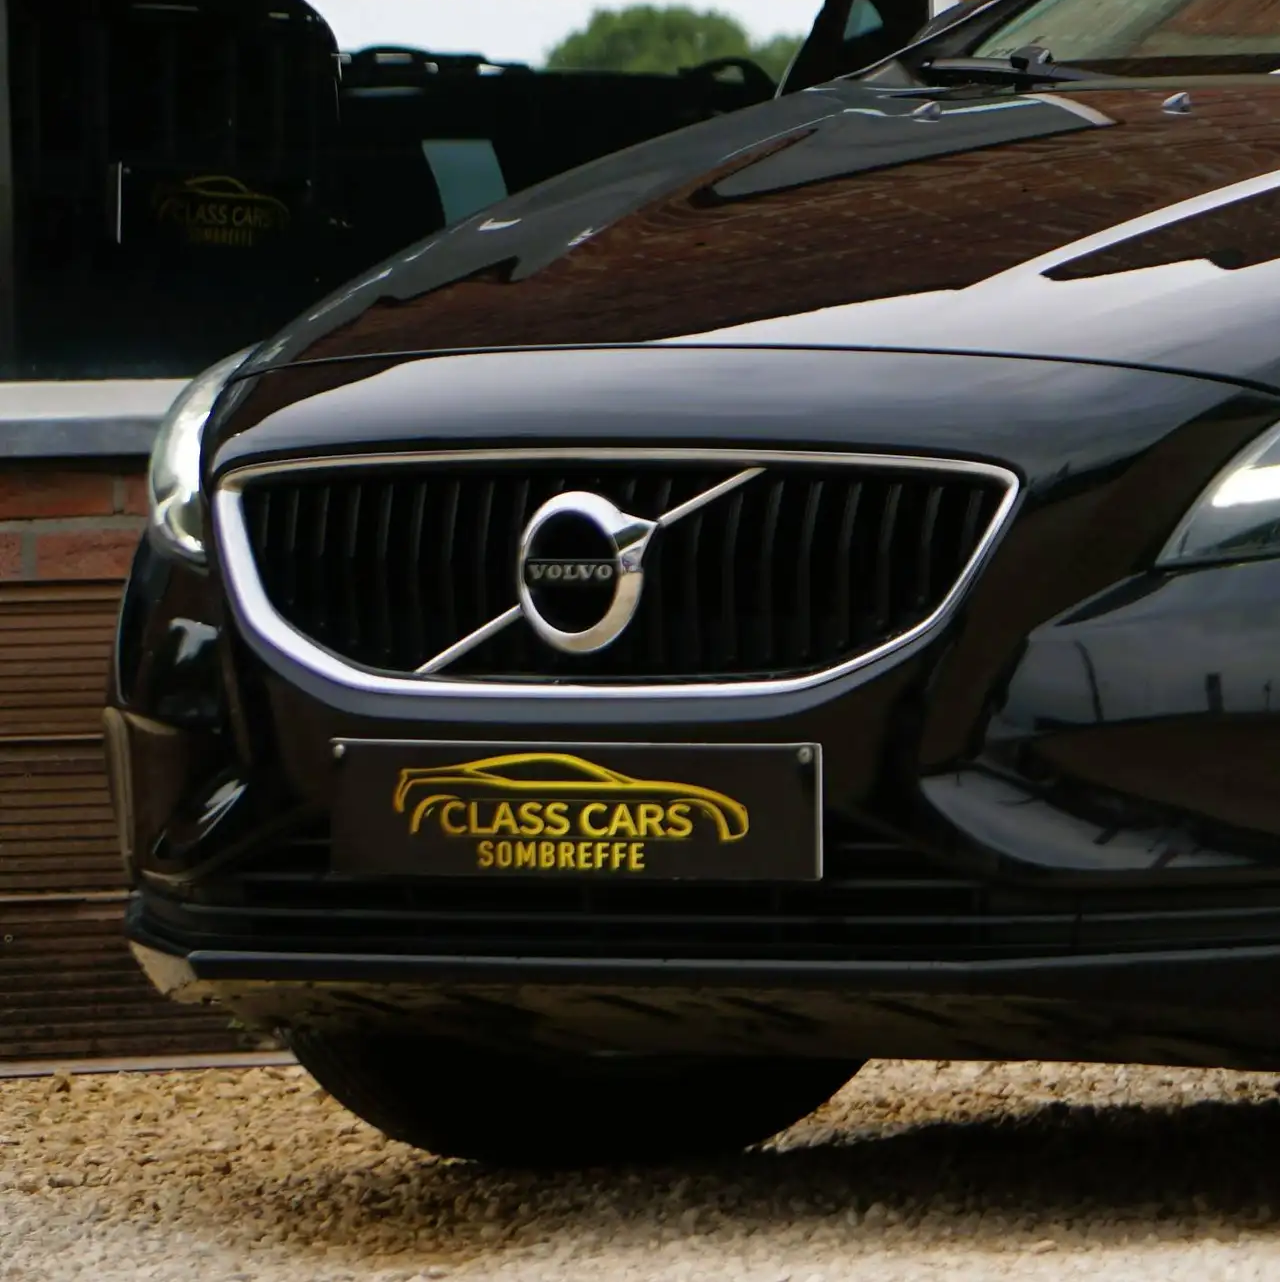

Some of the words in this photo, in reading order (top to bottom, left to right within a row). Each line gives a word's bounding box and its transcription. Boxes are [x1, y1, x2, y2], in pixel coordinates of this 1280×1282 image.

[527, 563, 614, 581] VOLVO
[440, 799, 570, 837] CLASS
[579, 801, 693, 838] CARS
[476, 839, 645, 870] SOMBREFFE
